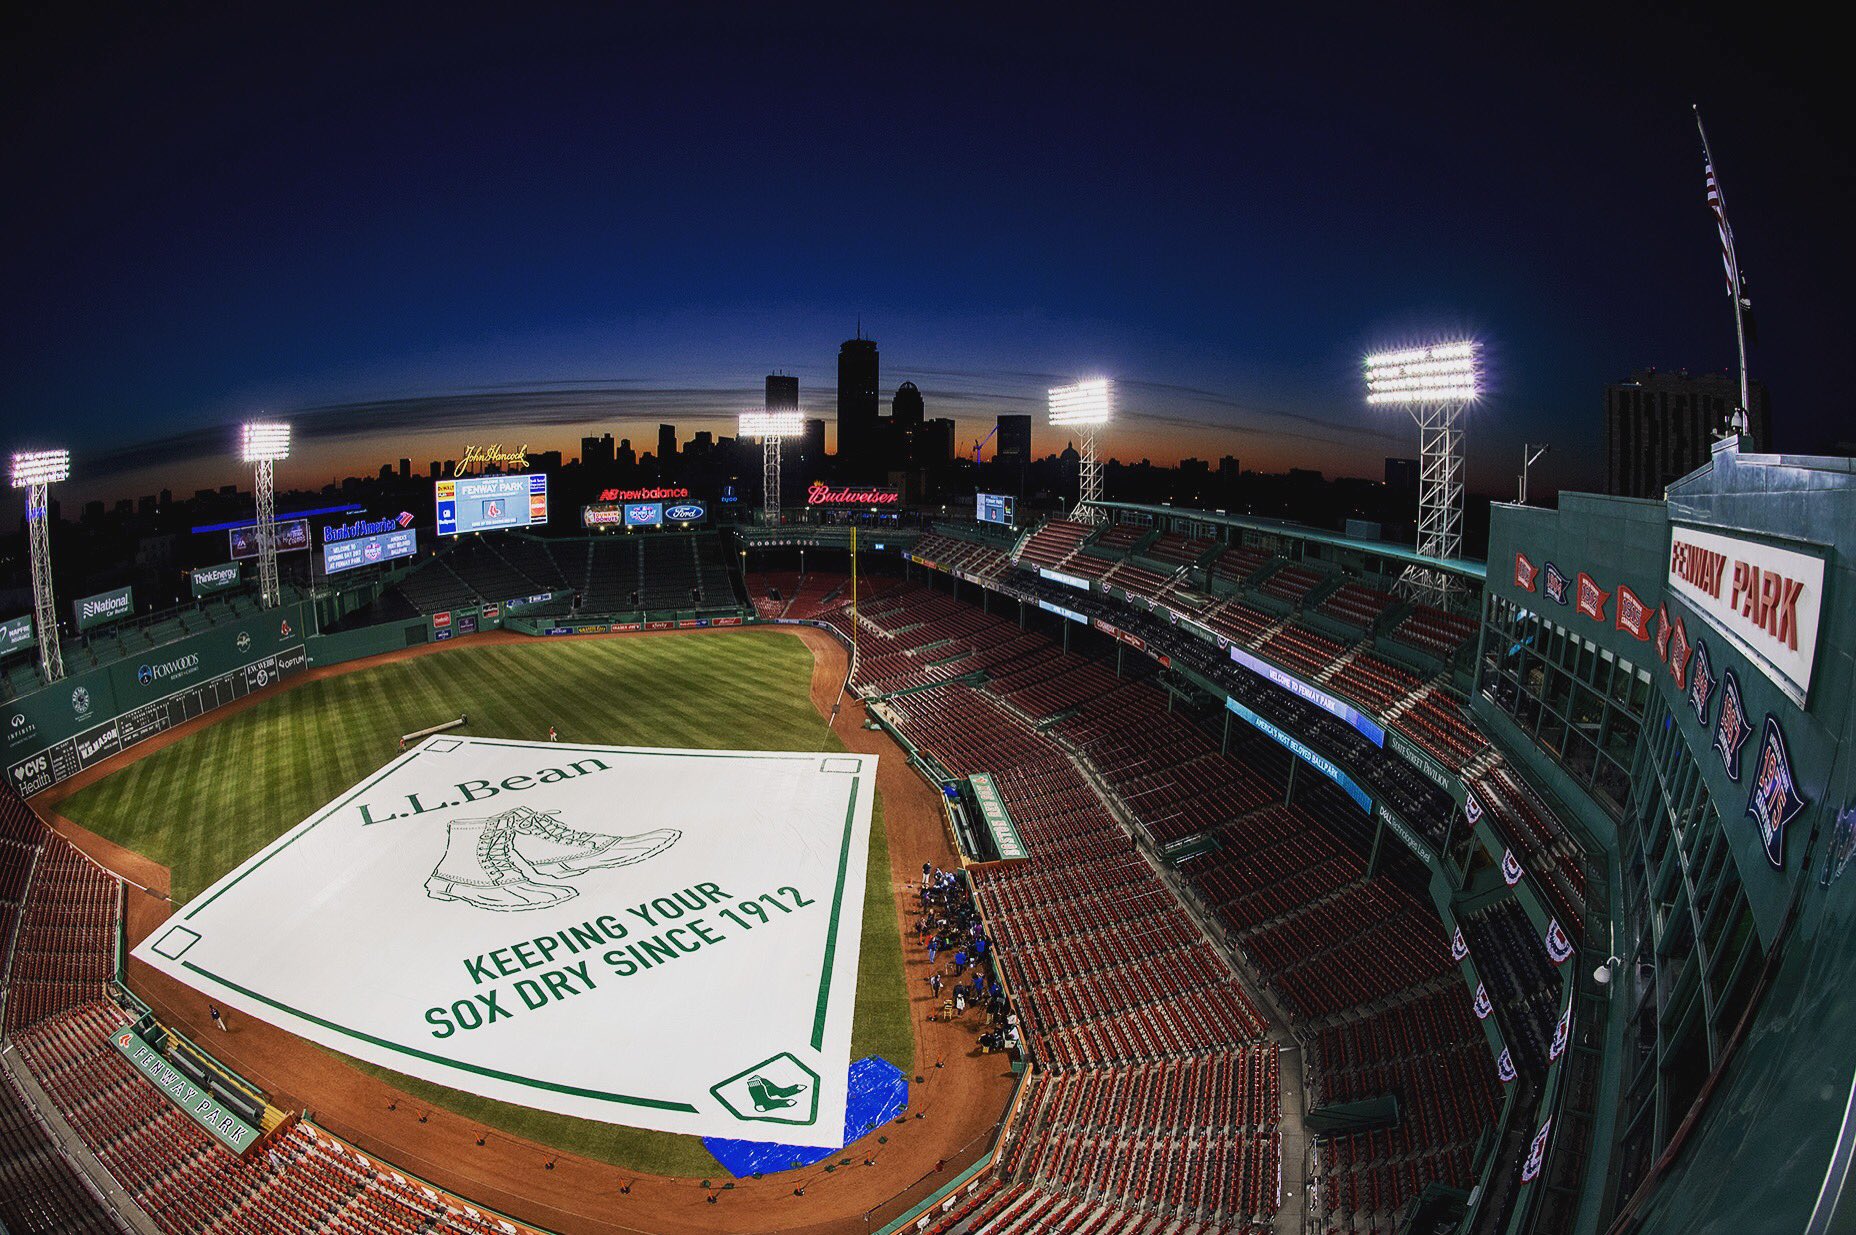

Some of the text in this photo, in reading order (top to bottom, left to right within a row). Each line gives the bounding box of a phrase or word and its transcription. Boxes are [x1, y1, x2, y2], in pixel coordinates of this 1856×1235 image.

[454, 444, 530, 477] John Hancock
[462, 484, 498, 495] FENWAY
[500, 482, 523, 493] PARK
[808, 485, 898, 504] Budweiser
[324, 523, 350, 541] Bank
[350, 520, 360, 537] of
[361, 517, 396, 536] America
[673, 508, 695, 518] Ford
[194, 569, 237, 584] ThinkEnergy
[93, 593, 128, 614] National
[1671, 540, 1727, 599] FENWAY
[1731, 559, 1804, 651] PARK
[153, 652, 199, 679] FOXWOODS
[285, 655, 304, 668] OPTUM
[1269, 669, 1336, 711] WELCOME TO FENWAY PARK
[25, 756, 47, 777] CVS
[1277, 731, 1290, 746] MOST
[1290, 740, 1312, 760] BELOVED
[1311, 753, 1338, 779] BALLPARK
[1392, 738, 1449, 789] STATE STREET PAVILION
[19, 773, 51, 797] Health
[356, 758, 612, 826] L.L.Bean
[1759, 745, 1787, 831] 1975
[1380, 806, 1392, 824] DELL
[1417, 844, 1430, 863] Level
[463, 882, 734, 985] KEEPING YOUR
[424, 886, 816, 1040] SOX DRY SINCE 1912
[133, 1047, 248, 1145] FENWAY PARK
